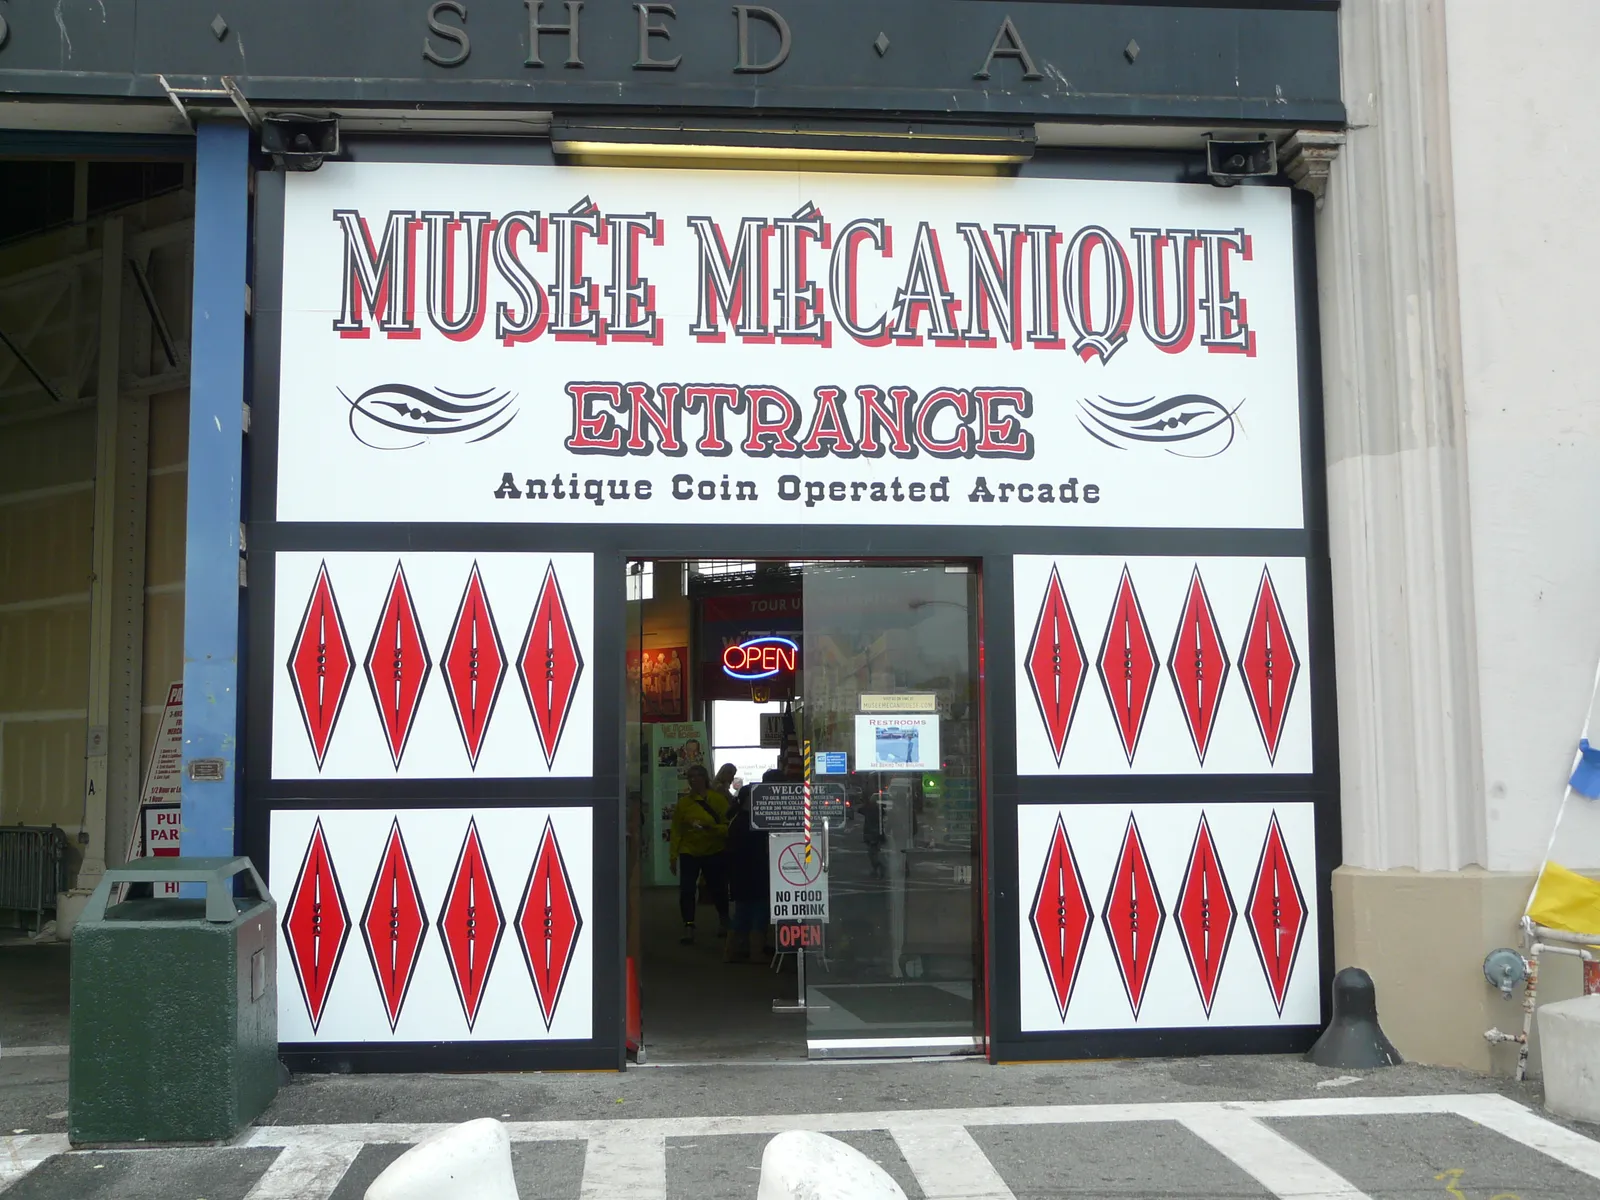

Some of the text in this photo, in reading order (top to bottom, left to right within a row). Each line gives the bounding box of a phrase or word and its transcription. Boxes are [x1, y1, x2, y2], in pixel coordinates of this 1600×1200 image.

[423, 1, 1043, 81] SHED A
[333, 195, 1257, 366] MUSÉE MÉCANIQUE
[564, 380, 1035, 460] ENTRANCE
[494, 472, 1101, 507] Antique Coin Operated Arcade
[750, 599, 788, 612] TOUR
[723, 645, 796, 671] OPEN
[88, 779, 95, 795] A
[771, 785, 826, 795] WELCME
[775, 890, 822, 902] NO FOOD
[774, 904, 825, 916] OR DRINK
[779, 924, 821, 947] OPEN
